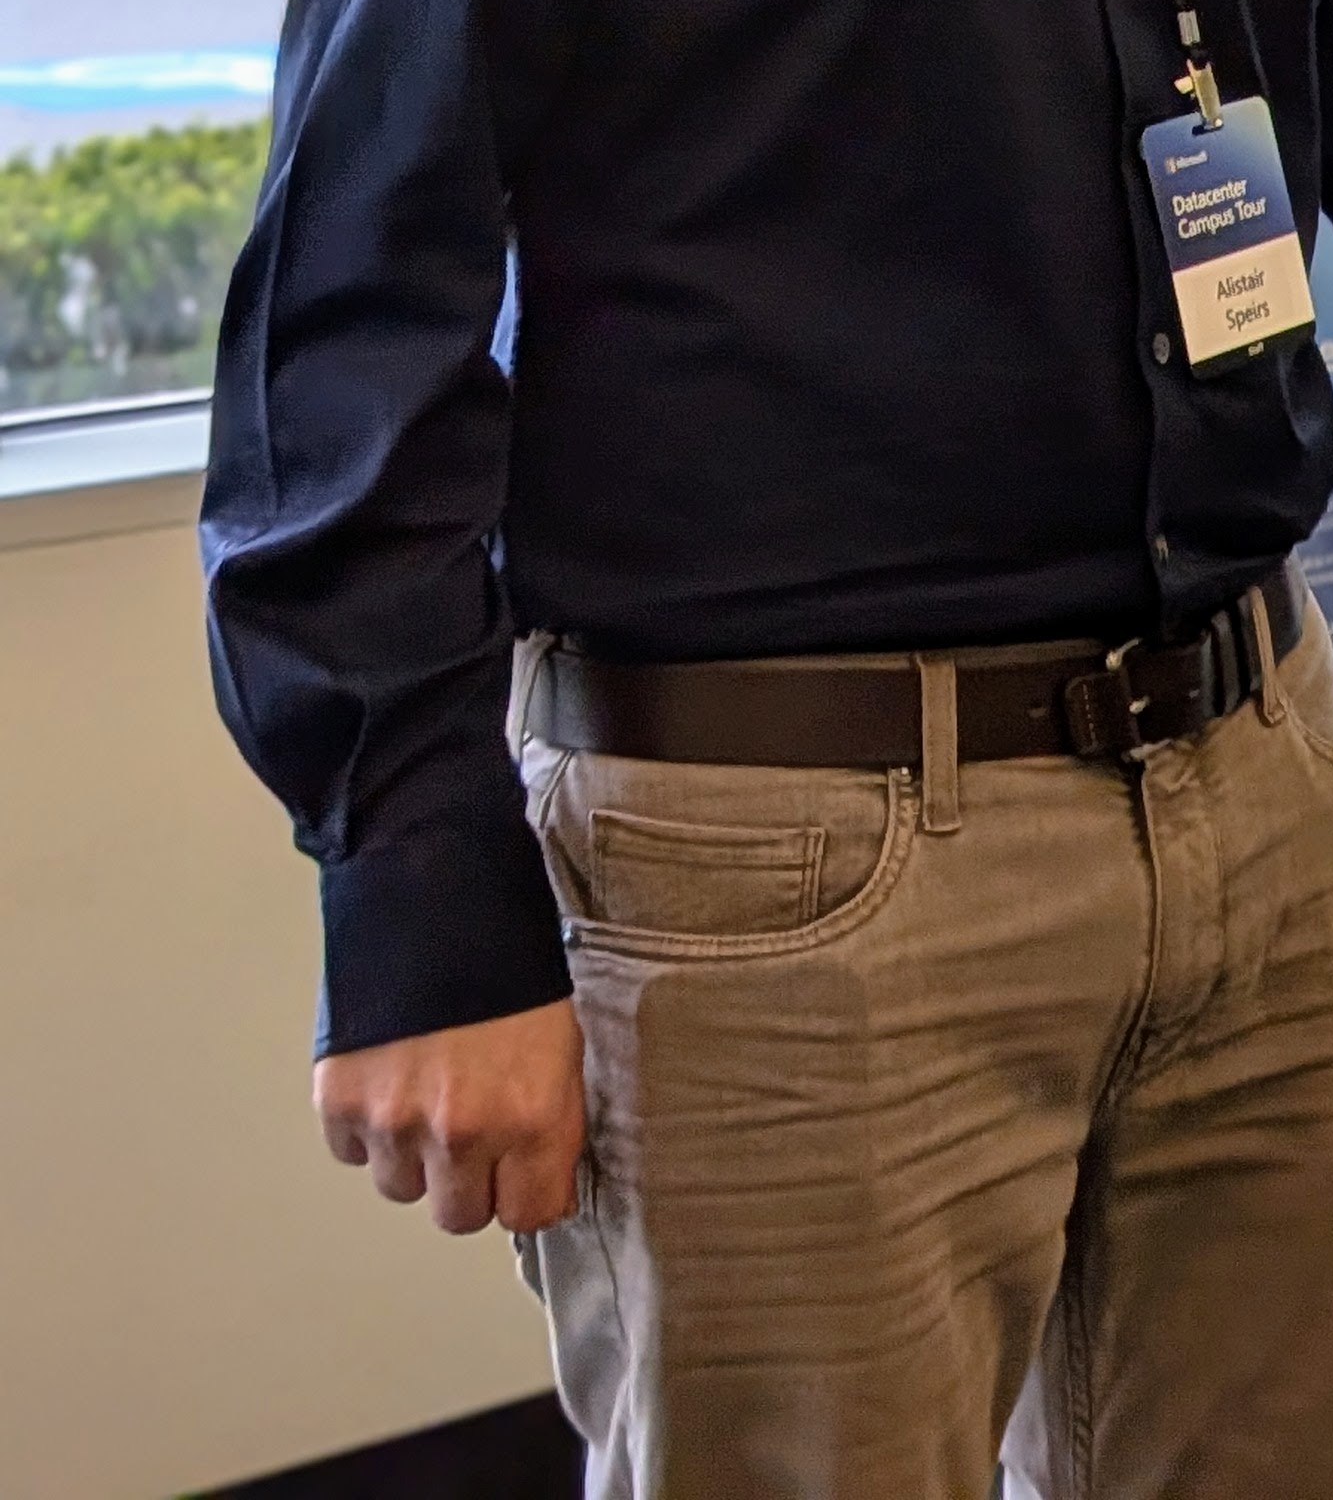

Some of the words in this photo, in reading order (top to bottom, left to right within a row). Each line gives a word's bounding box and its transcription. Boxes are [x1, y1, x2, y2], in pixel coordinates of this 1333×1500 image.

[1173, 179, 1247, 216] Datacenter
[1178, 208, 1235, 239] Campus
[1234, 196, 1266, 221] Tour
[1217, 268, 1265, 301] Alistair
[1225, 292, 1271, 332] Speirs
